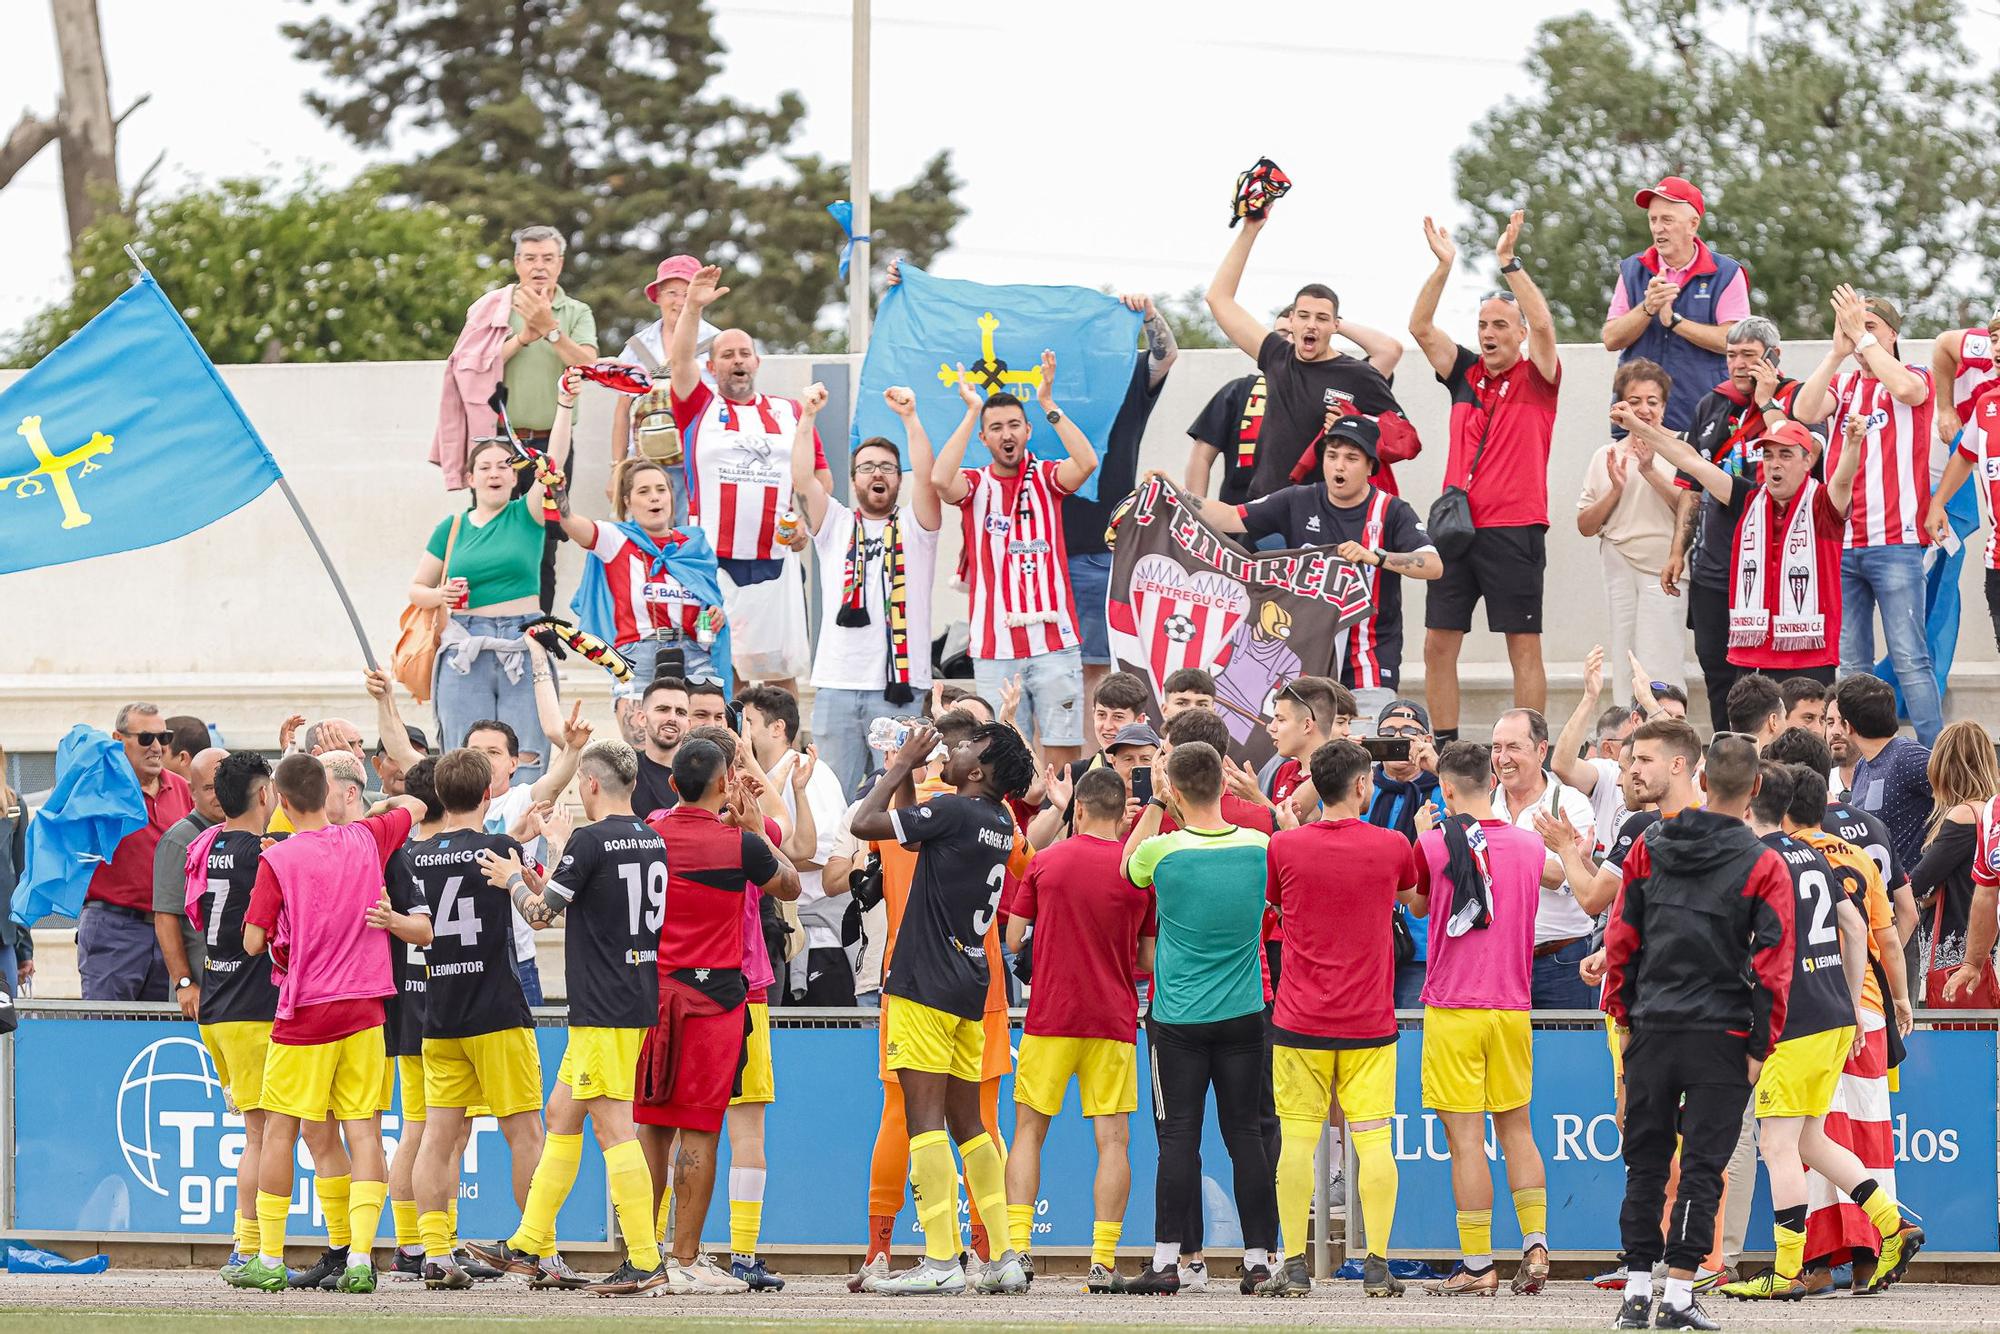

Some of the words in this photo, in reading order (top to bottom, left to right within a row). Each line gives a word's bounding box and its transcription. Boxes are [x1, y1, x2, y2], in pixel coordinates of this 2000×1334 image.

[718, 468, 754, 476] TALLERES
[1135, 579, 1211, 606] L'ENTREGU
[1215, 598, 1239, 612] C.F.
[1775, 622, 1809, 633] L'ENTREGU
[1839, 822, 1869, 840] EDU
[604, 838, 638, 852] BORJA
[207, 854, 234, 870] EVEN
[415, 850, 487, 867] CASARIEGO
[1782, 850, 1816, 864] DANI
[618, 861, 668, 935] 19
[973, 863, 1006, 936] 3
[206, 878, 230, 946] 7
[416, 876, 482, 947] 4
[1799, 869, 1837, 945] 2
[431, 960, 484, 977] LEOMOTOR
